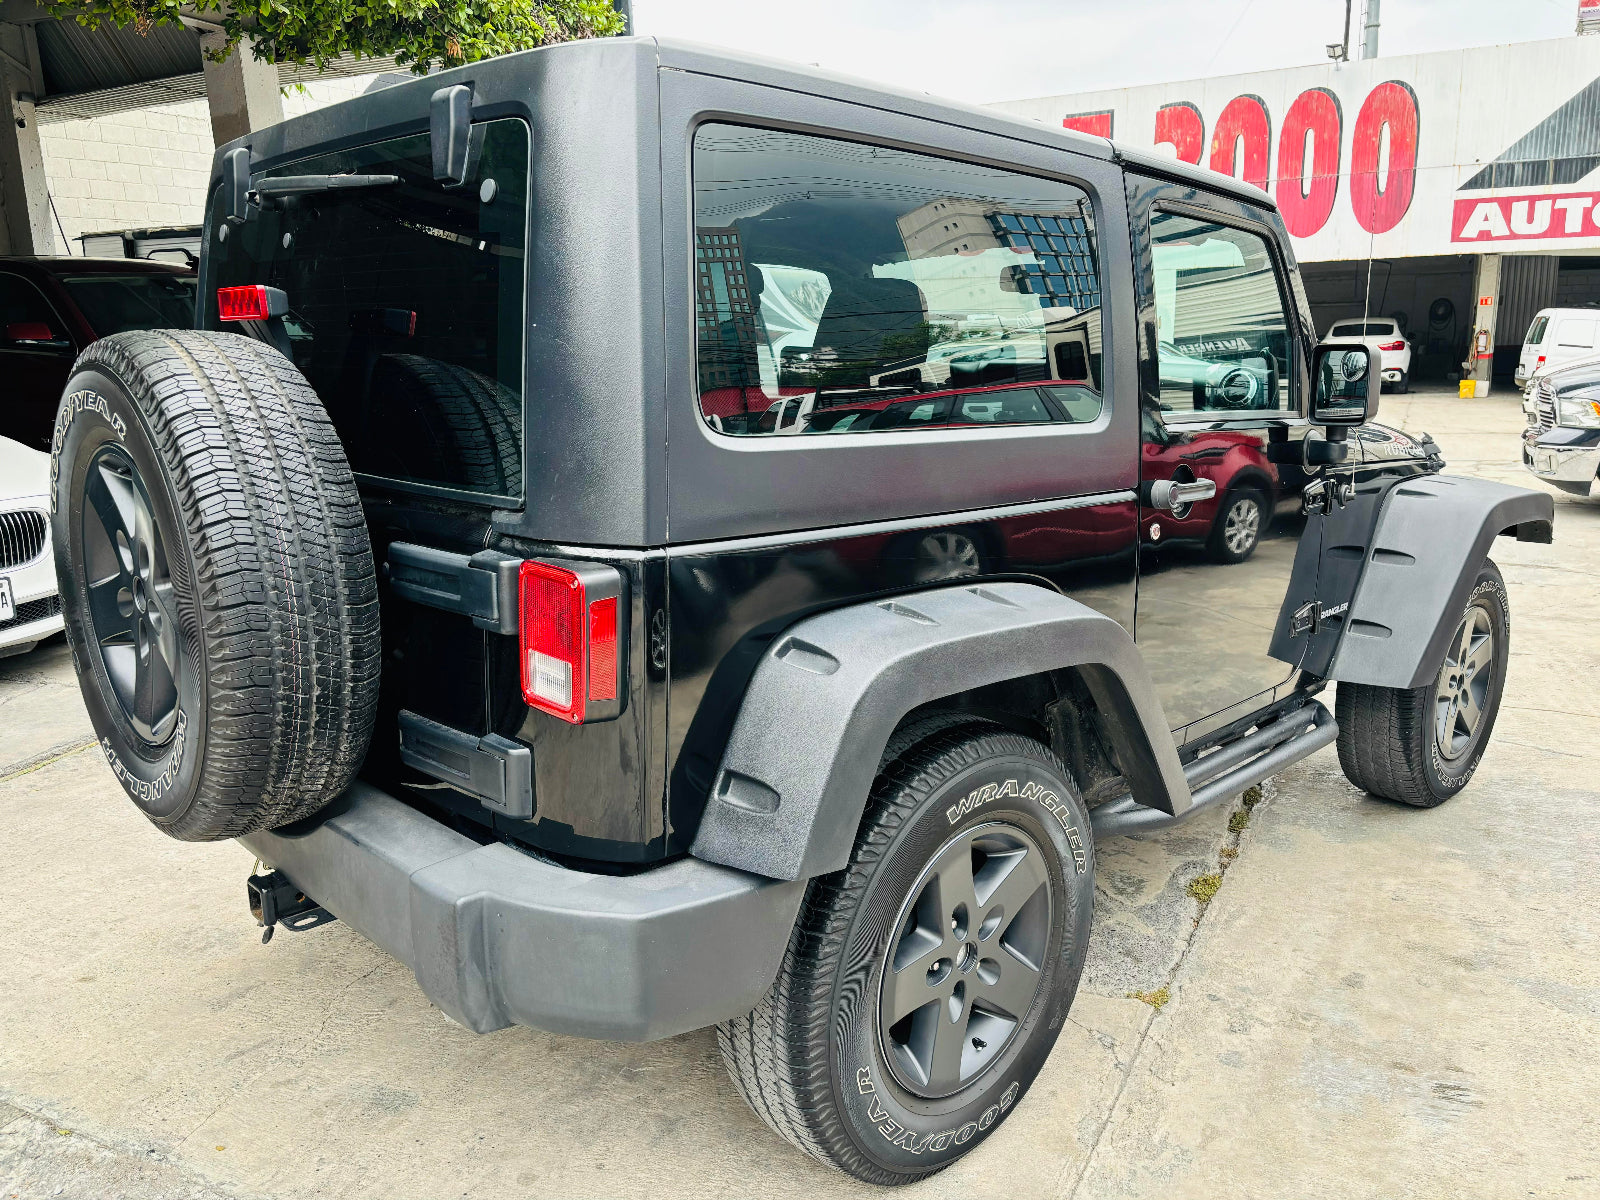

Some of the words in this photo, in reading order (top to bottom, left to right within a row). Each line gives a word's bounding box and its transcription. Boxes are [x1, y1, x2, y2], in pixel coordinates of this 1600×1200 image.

[1459, 197, 1600, 238] AUT
[51, 389, 127, 513] GOODYEAR
[1320, 601, 1349, 620] RANGLER
[102, 708, 187, 801] WRANGLER
[945, 779, 1087, 875] WRANGLER
[856, 1065, 1020, 1155] GOODYEAR
